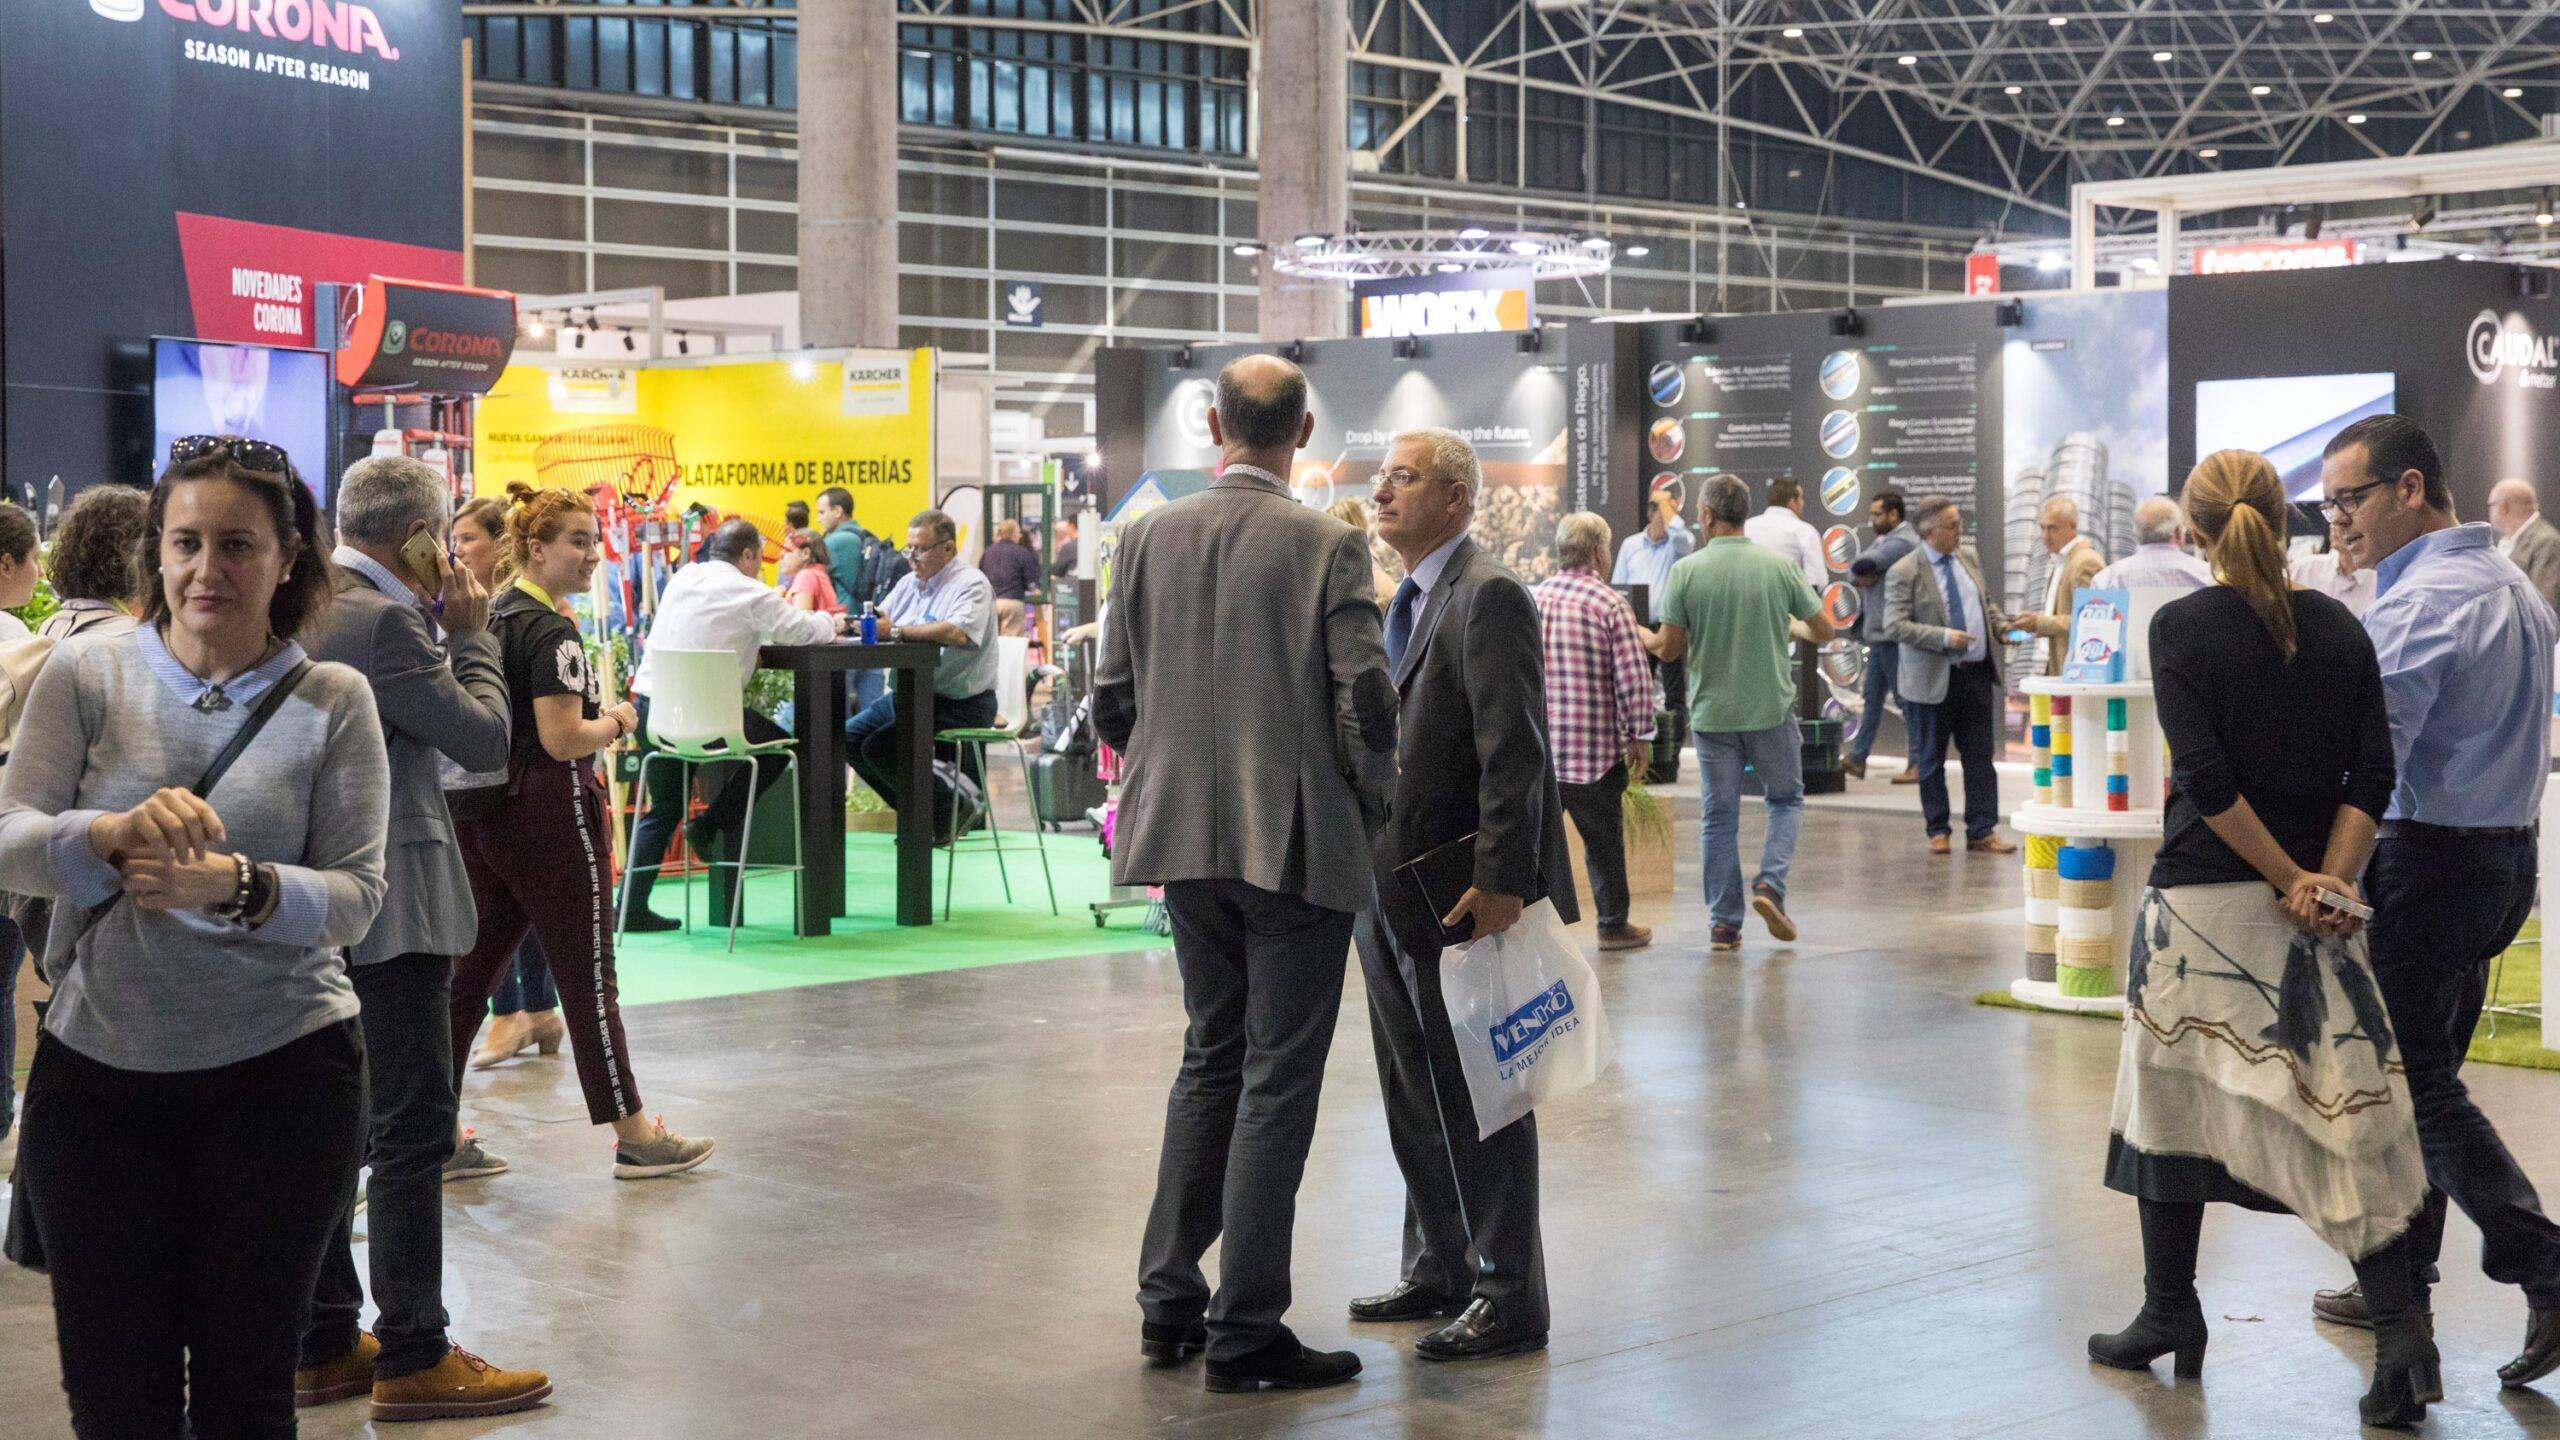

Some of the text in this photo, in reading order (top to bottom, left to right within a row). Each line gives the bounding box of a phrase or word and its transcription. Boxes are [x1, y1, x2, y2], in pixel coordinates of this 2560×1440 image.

[184, 38, 370, 91] SEASON AFTER SEASON
[231, 267, 303, 304] NOVEDADES
[253, 302, 303, 336] CORONA
[409, 327, 503, 359] CORONA
[1345, 429, 1372, 445] Drop
[1373, 428, 1387, 445] by
[1473, 426, 1492, 441] the
[1574, 416, 1588, 441] de
[677, 454, 912, 486] PLATAFORMA DE BATERÍAS
[573, 800, 583, 816] LOVE
[594, 961, 602, 980] TRUST
[599, 1020, 611, 1048] RESPECT
[606, 1059, 618, 1077] TRUST
[1494, 991, 1568, 1052] VENKO
[1500, 1067, 1515, 1081] LA
[1551, 1017, 1581, 1043] IDEA
